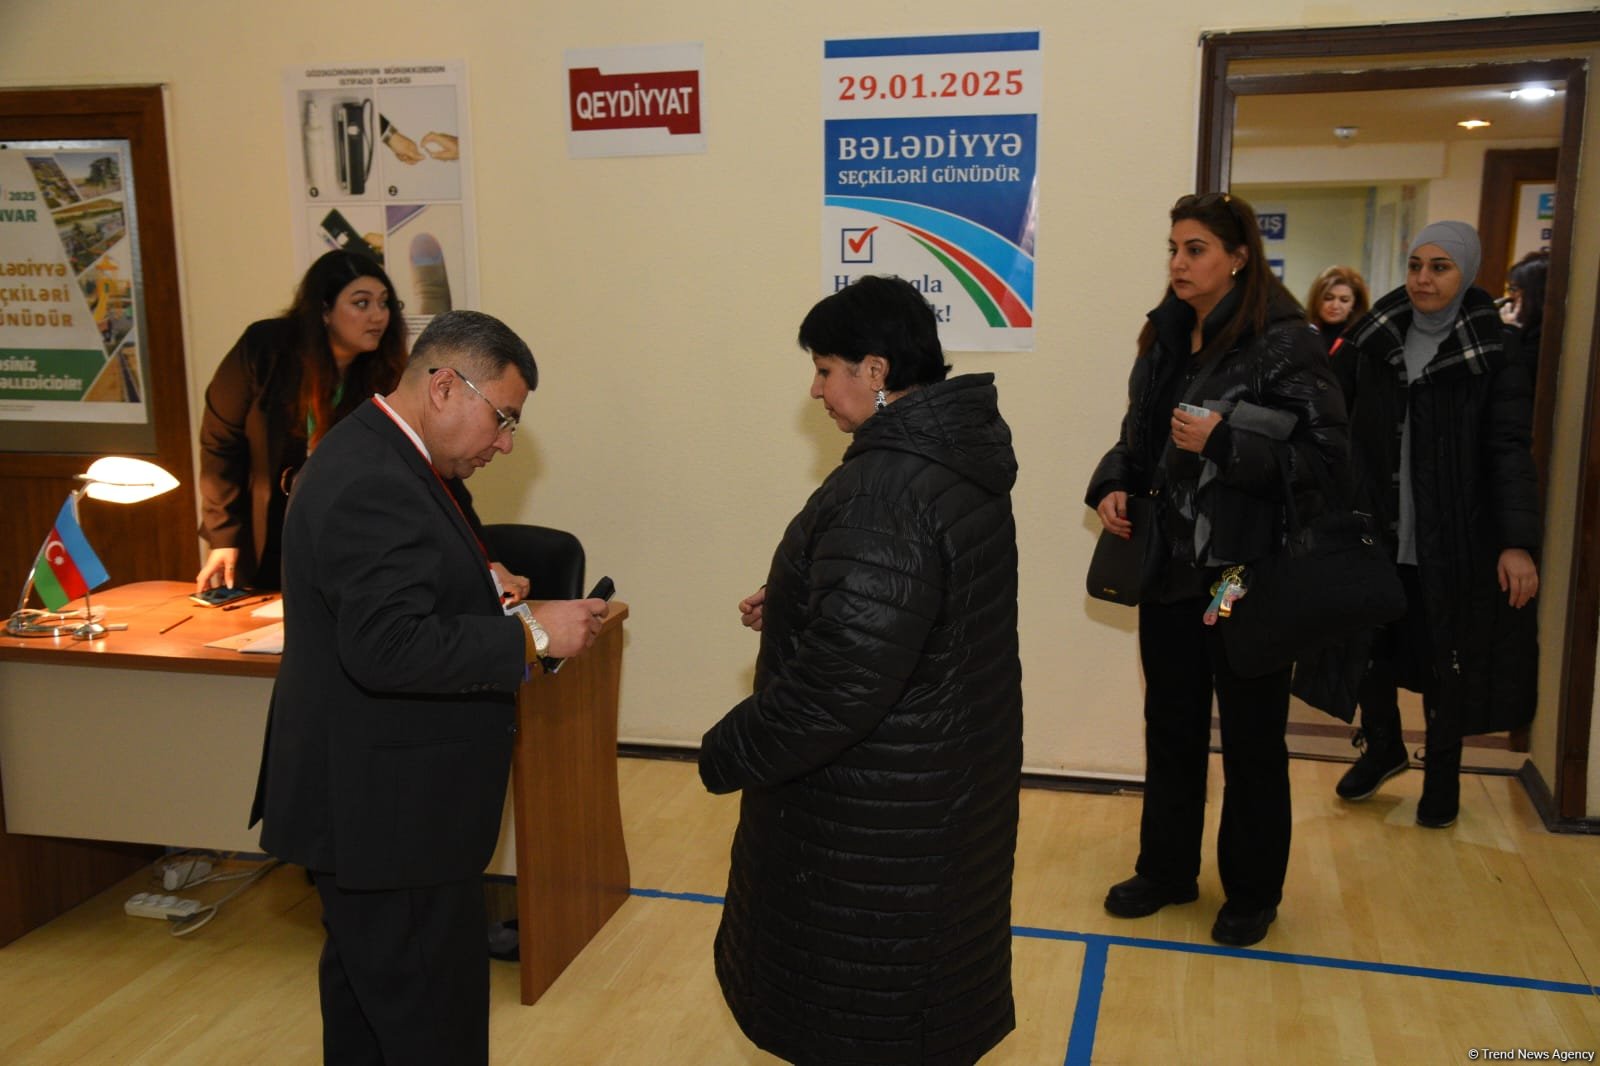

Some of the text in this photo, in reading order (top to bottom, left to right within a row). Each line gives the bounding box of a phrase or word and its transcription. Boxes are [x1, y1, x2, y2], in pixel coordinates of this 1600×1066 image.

[838, 69, 1023, 101] 29.01.2025
[576, 82, 693, 120] QEYDİYYAT
[838, 129, 1022, 160] BƏLƏDİYYƏ
[838, 164, 1021, 187] SEÇKİLƏRİ GÜNÜDÜR
[9, 191, 36, 201] 2025
